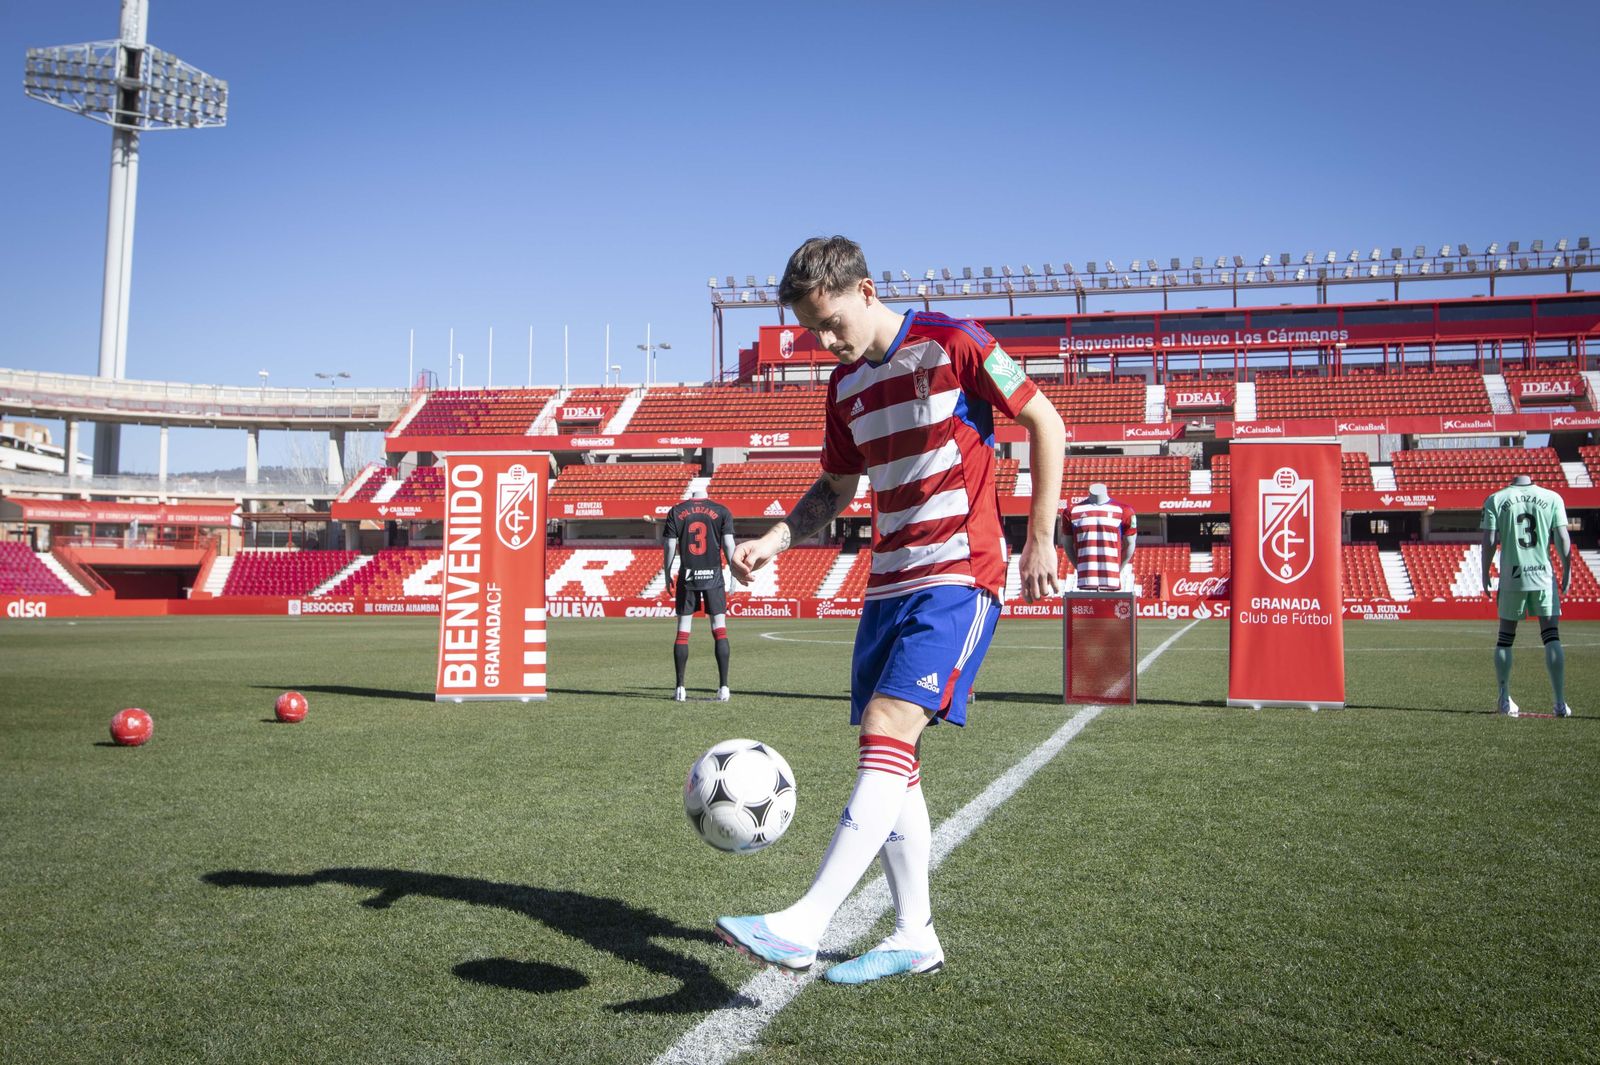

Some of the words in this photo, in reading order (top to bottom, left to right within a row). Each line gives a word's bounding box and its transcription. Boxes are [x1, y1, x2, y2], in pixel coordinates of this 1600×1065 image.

[1059, 334, 1154, 351] Bienvenidos
[1161, 333, 1175, 346] al
[1181, 332, 1229, 346] Nuevo
[1235, 331, 1262, 344] Los
[1267, 328, 1349, 343] Cármenes
[1521, 381, 1575, 394] IDEAL
[1175, 392, 1224, 404] IDEAL
[562, 406, 605, 417] IDEAL
[1454, 420, 1493, 429] CaixaBank
[1563, 416, 1600, 425] CaixaBan
[1135, 428, 1171, 436] CaixaBank
[1245, 425, 1282, 434] CaixaBank
[1348, 423, 1386, 431] CaixaBank
[1501, 499, 1514, 512] POL
[1515, 495, 1548, 510] LOZANO
[678, 509, 690, 521] POL
[691, 506, 719, 520] LOZANO
[1516, 513, 1538, 549] 3
[688, 521, 708, 556] 3
[443, 464, 484, 688] BIENVENIDO
[6, 598, 47, 618] alsa
[302, 602, 354, 613] BESOCCER
[375, 603, 404, 613] CERVEZAS
[405, 603, 439, 613] ALHAMBRA
[731, 603, 792, 617] CaixaBank
[1013, 605, 1050, 615] CERVEZAS
[1251, 598, 1320, 610] GRANADA
[1350, 605, 1374, 614] CAJA
[1377, 605, 1411, 614] RURAL
[823, 607, 856, 617] Greening
[1137, 602, 1190, 619] LaLiga
[1239, 611, 1268, 624] Club
[1272, 612, 1288, 624] de
[1292, 611, 1332, 625] Fútbol
[916, 680, 940, 694] adidas
